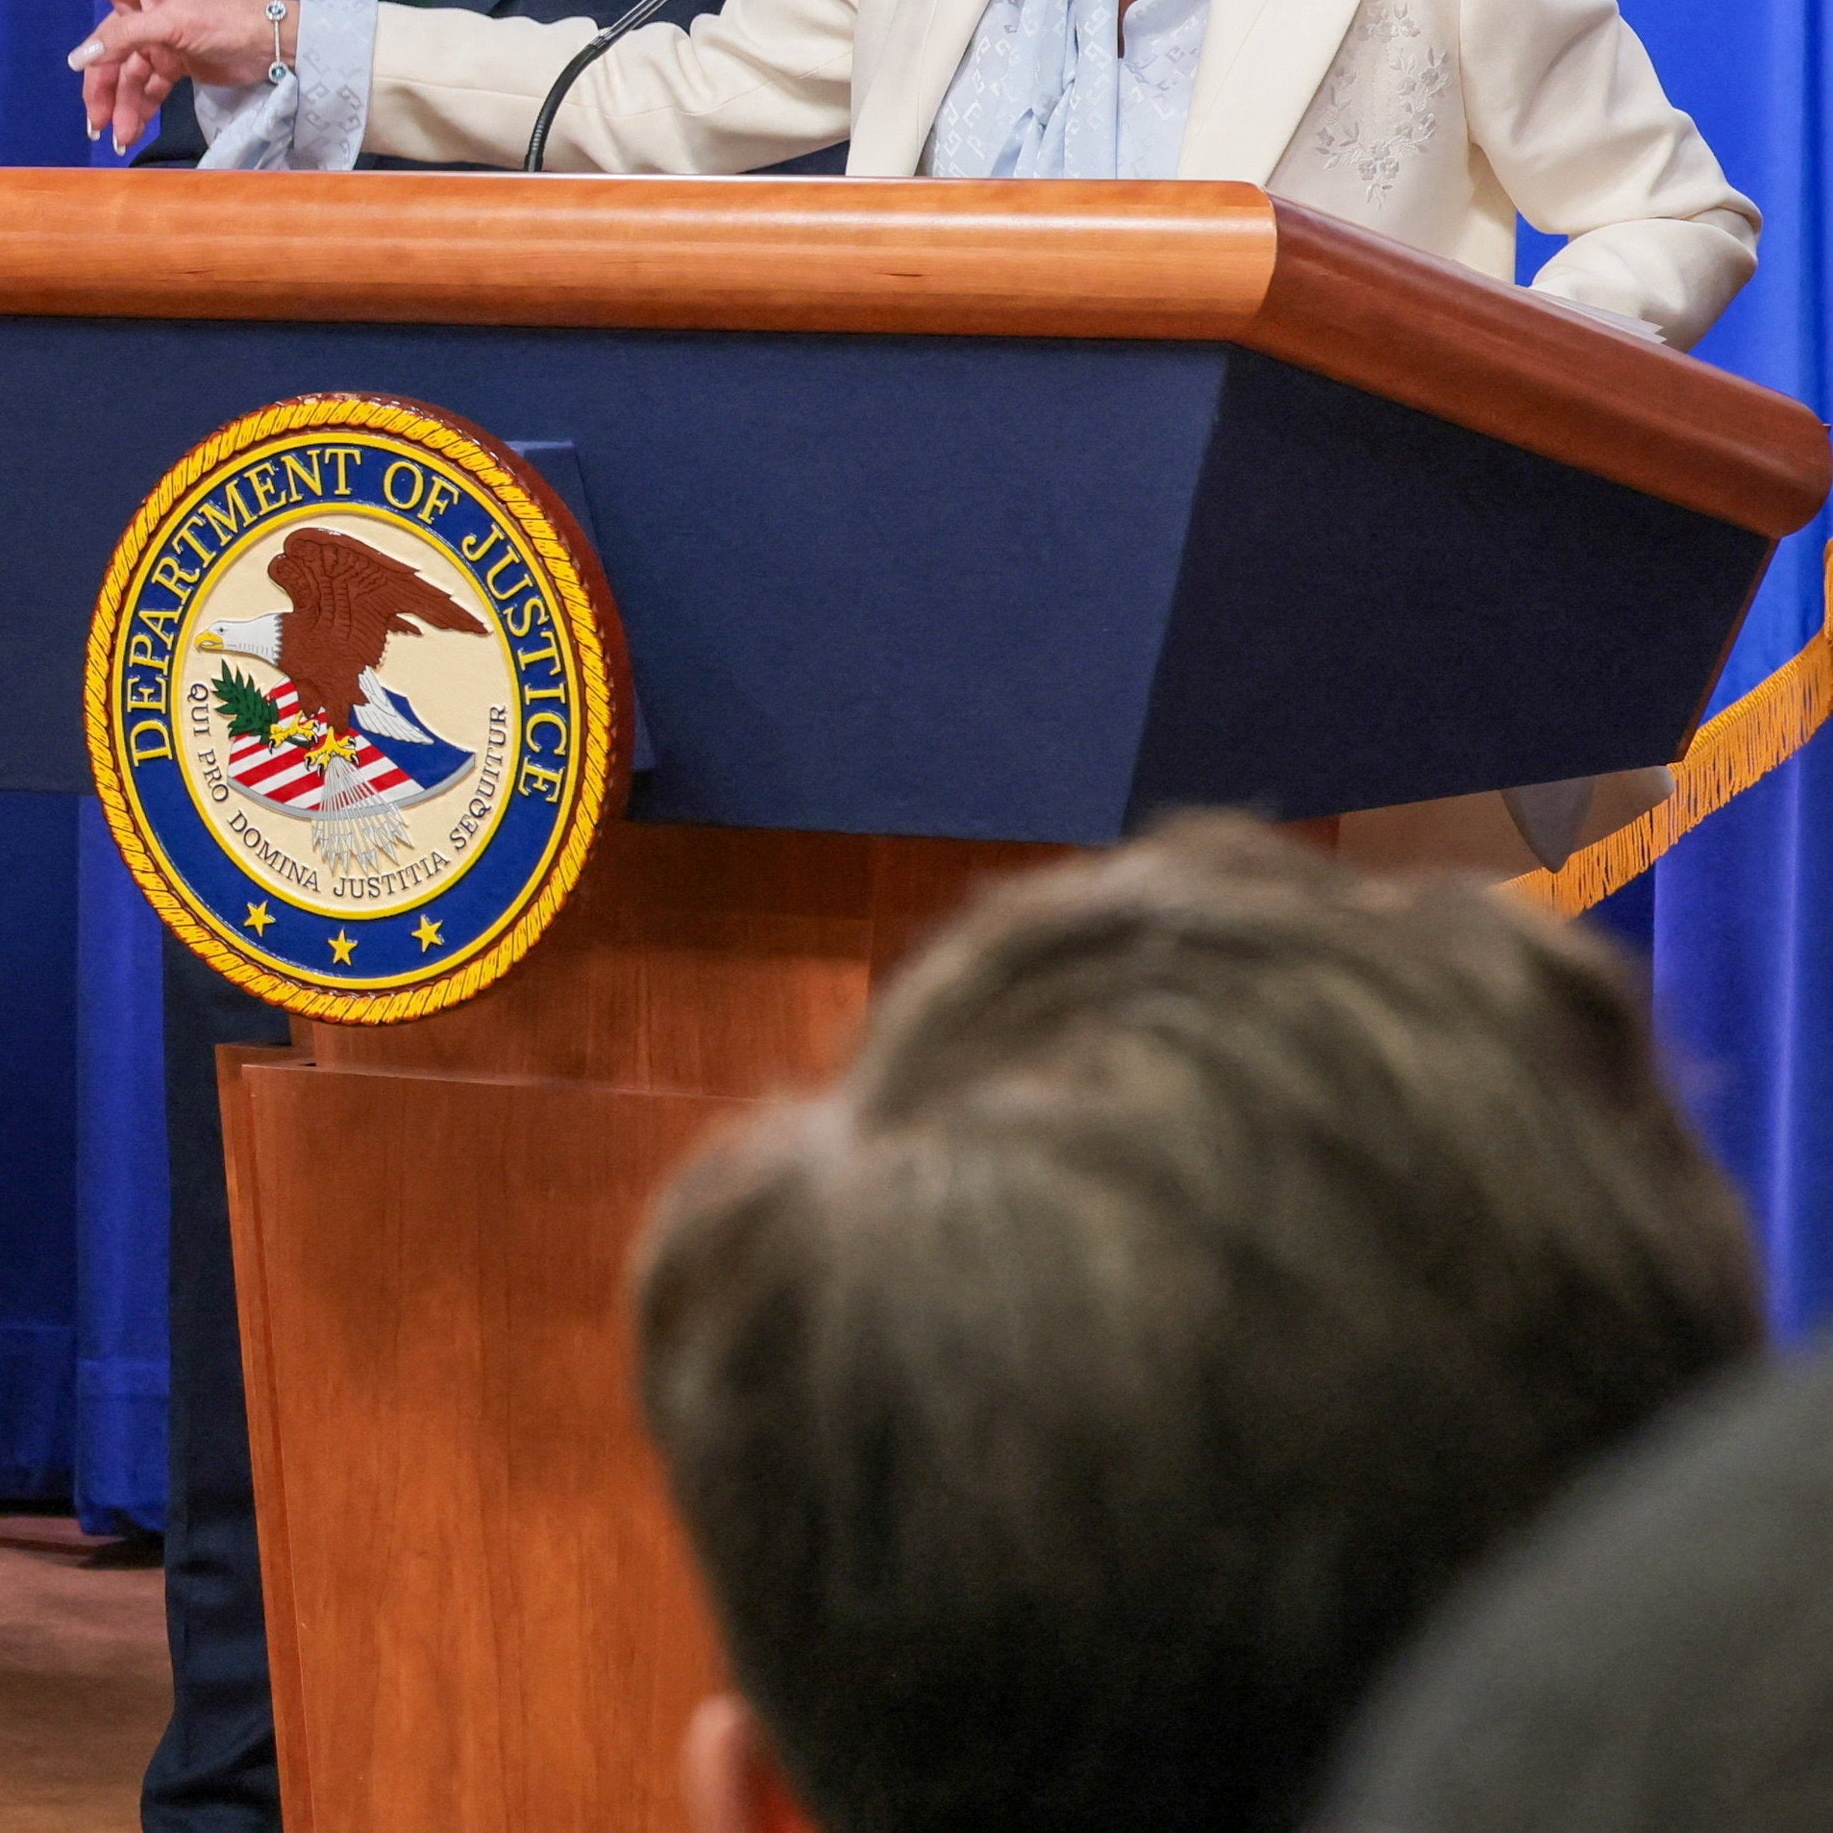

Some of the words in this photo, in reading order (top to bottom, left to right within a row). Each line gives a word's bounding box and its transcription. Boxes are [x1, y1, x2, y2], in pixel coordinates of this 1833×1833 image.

[127, 447, 362, 766] DEPARTMENT
[382, 462, 462, 525] OF
[461, 525, 570, 804] JUSTICE
[186, 682, 211, 736] QUI
[197, 746, 231, 804] PRO
[448, 704, 508, 852] SEQUITUR
[227, 810, 321, 893] DOMINA
[332, 851, 451, 900] JUSTITIA
